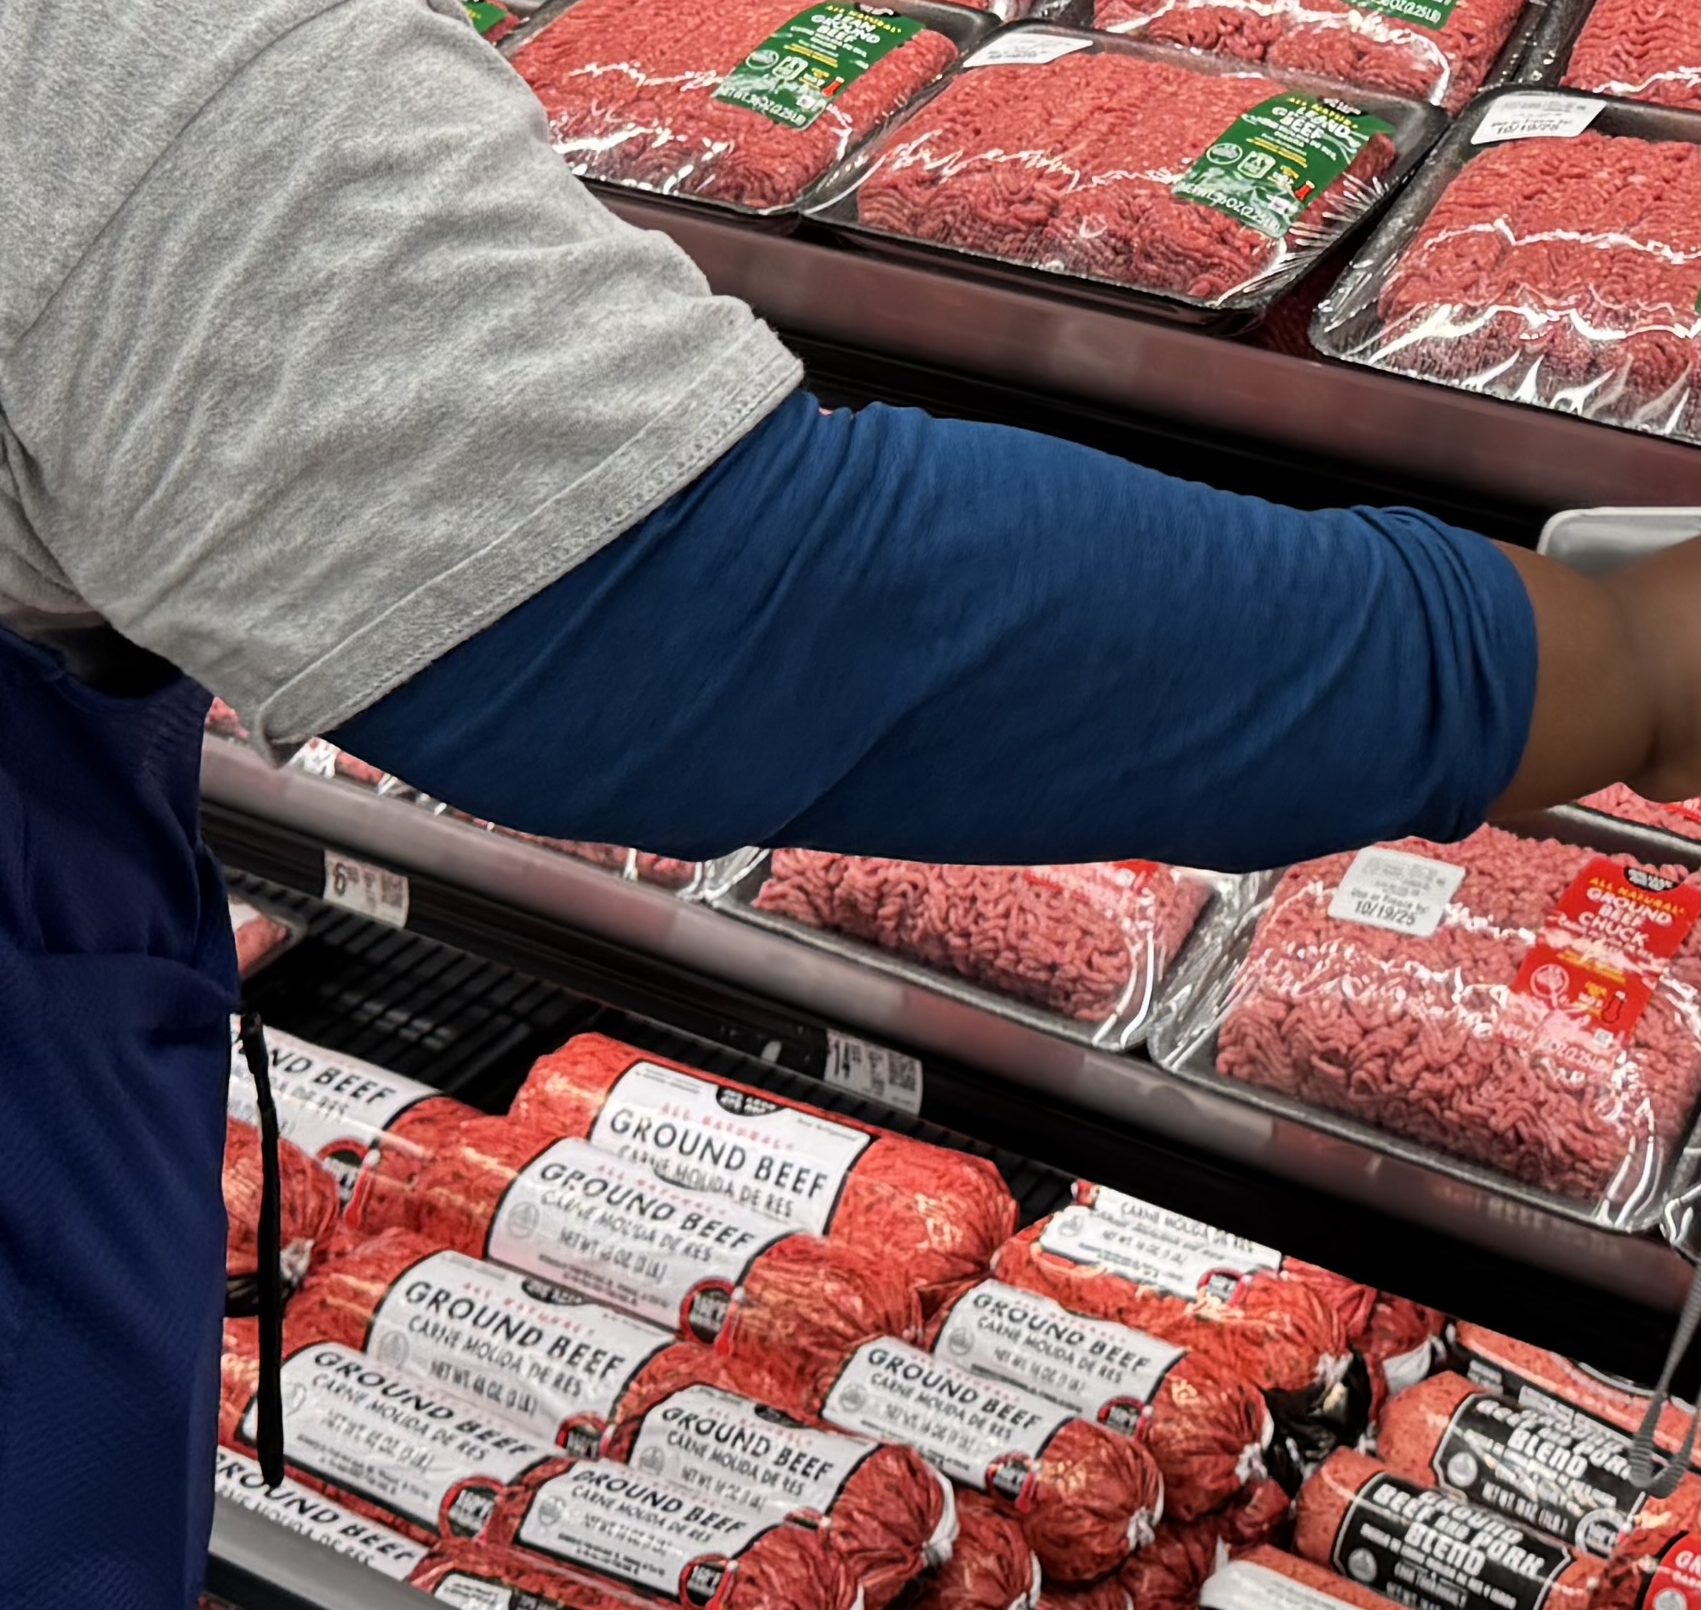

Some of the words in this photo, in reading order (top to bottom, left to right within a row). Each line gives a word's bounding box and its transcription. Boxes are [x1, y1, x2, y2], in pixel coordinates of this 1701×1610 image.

[1355, 900, 1416, 926] 10/19/25
[1587, 886, 1672, 926] GROUND
[610, 1107, 747, 1172] GROUND
[754, 1156, 828, 1200] BEEF
[540, 1162, 675, 1222] GROUND
[680, 1209, 756, 1251] BEEF
[405, 1280, 543, 1346] GROUND
[549, 1338, 625, 1379] BEEF
[408, 1316, 457, 1348] CARNE
[462, 1338, 522, 1374] MOLIDA
[529, 1361, 550, 1384] DE
[554, 1371, 583, 1398] RES
[973, 1293, 1086, 1346] GROUND
[1089, 1336, 1151, 1372] BEEF
[314, 1351, 454, 1420] GROUND
[456, 1417, 536, 1456] BEEF
[867, 1347, 979, 1405] GROUND
[982, 1394, 1042, 1429] BEEF
[662, 1407, 771, 1458] GROUND
[773, 1446, 834, 1482] BEEF
[1507, 1427, 1588, 1479] BLEND
[1404, 1522, 1486, 1577] BLEND
